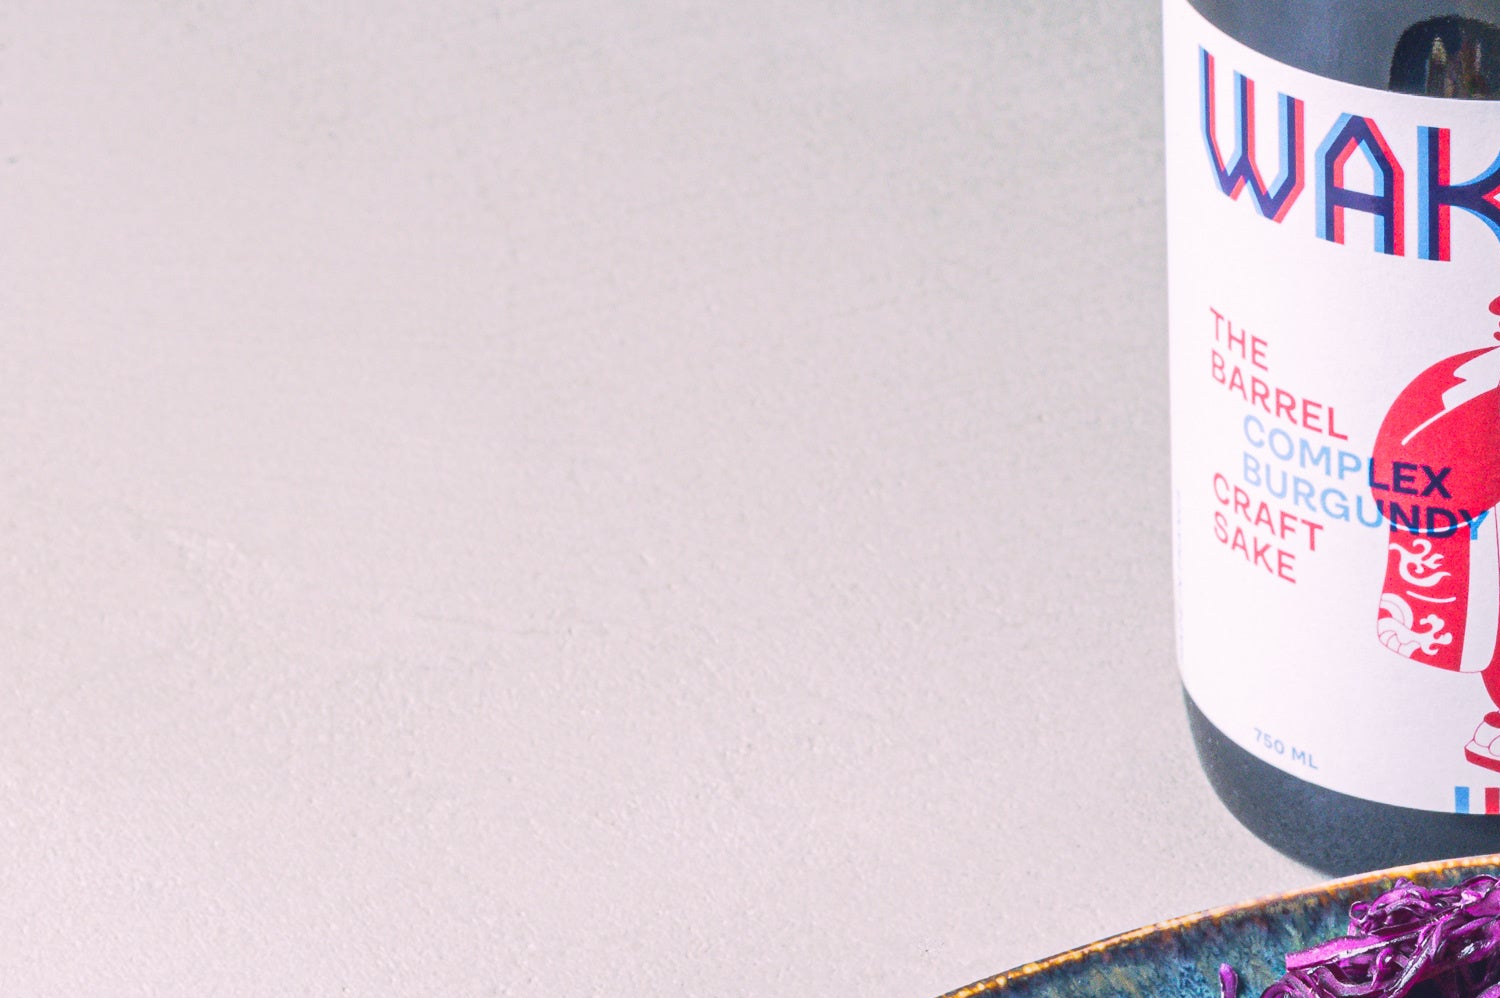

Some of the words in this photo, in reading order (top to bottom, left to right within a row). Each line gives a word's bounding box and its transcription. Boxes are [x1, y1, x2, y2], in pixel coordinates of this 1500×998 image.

[1210, 307, 1268, 372] THE
[1212, 349, 1348, 440] BARREL
[1243, 451, 1489, 540] BURGUNDY
[1244, 414, 1452, 499] COMPLEX
[1213, 473, 1324, 551] CRAFT
[1214, 511, 1296, 584] SAKE
[1254, 727, 1285, 755] 750
[1292, 746, 1318, 770] ML
